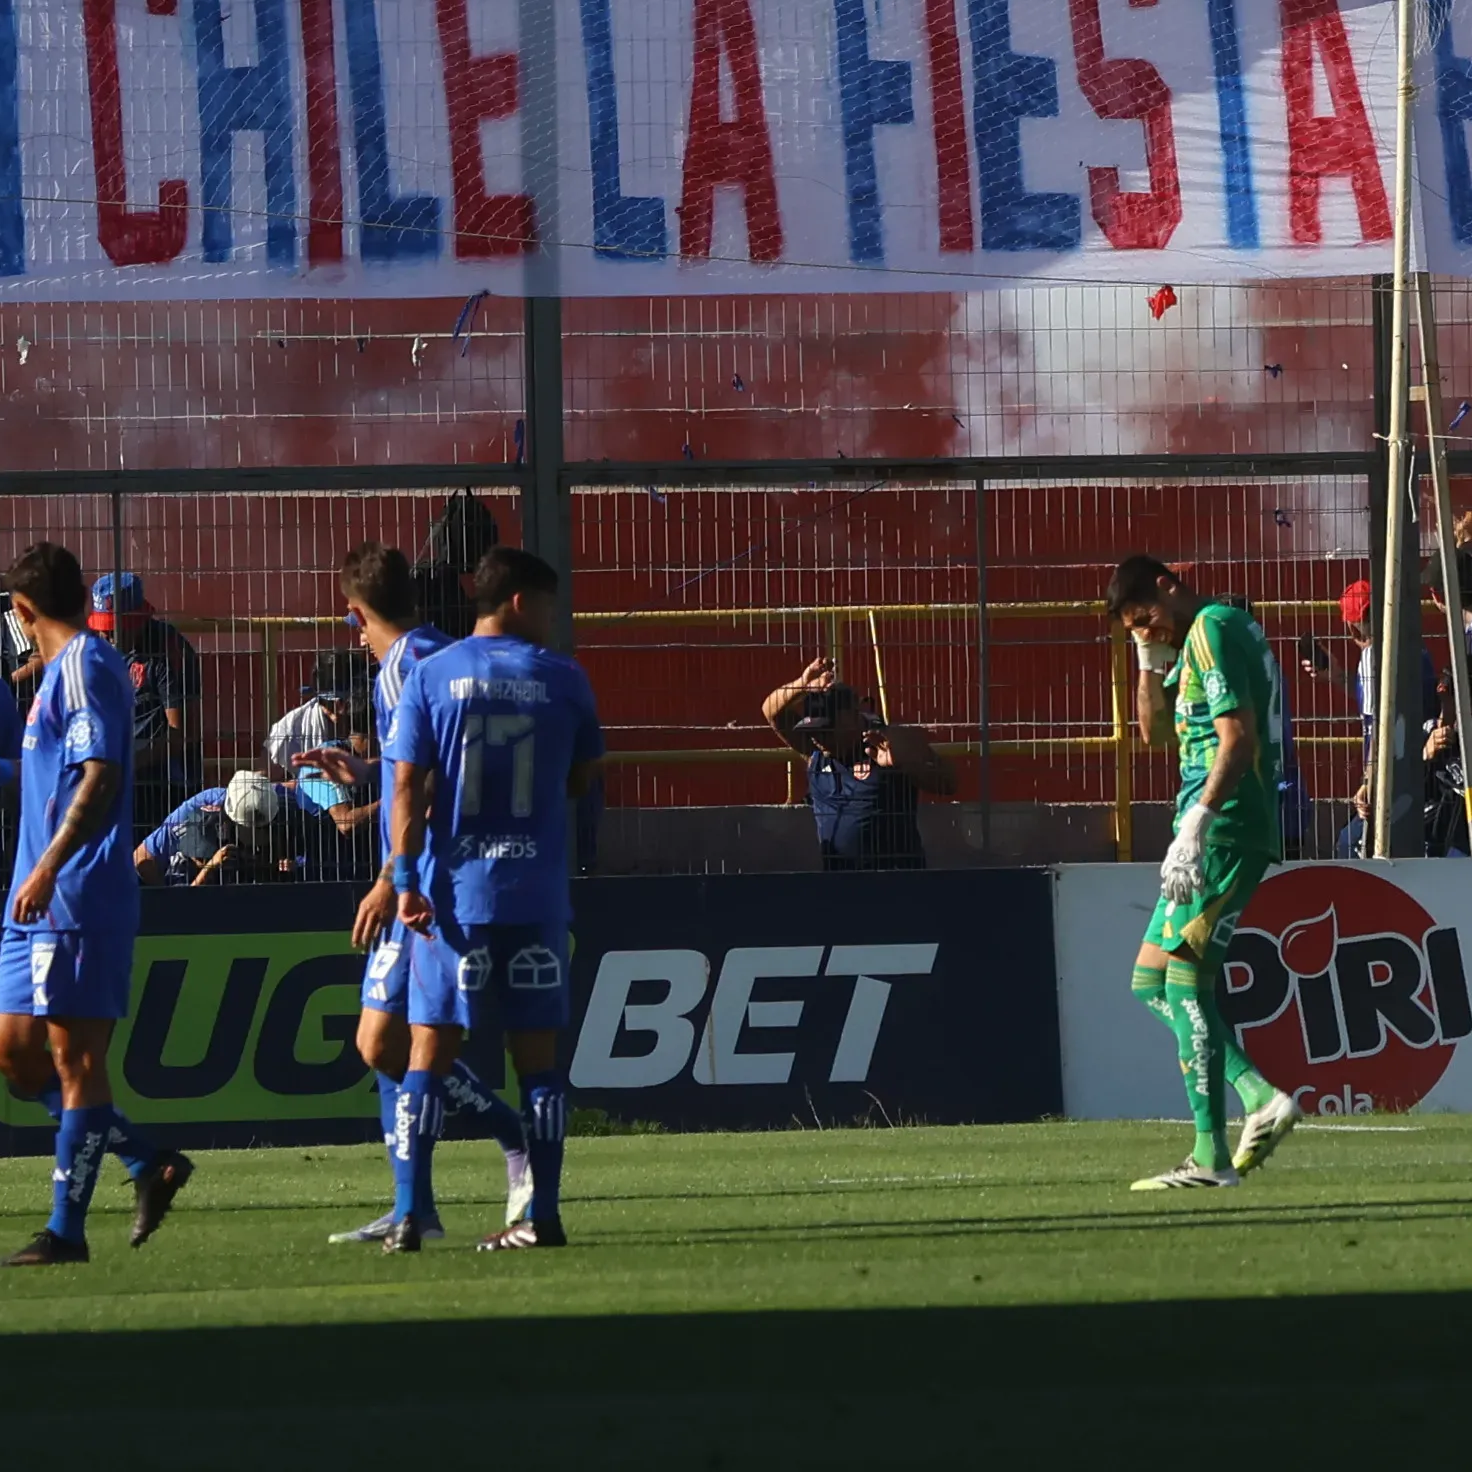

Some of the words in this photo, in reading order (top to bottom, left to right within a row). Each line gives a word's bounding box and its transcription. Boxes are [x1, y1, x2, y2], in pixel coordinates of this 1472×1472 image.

[460, 714, 535, 819] 17
[479, 841, 536, 859] MEDS
[570, 942, 939, 1088] BET
[1181, 998, 1215, 1096] AutoPlanet
[1290, 1083, 1375, 1114] Cola
